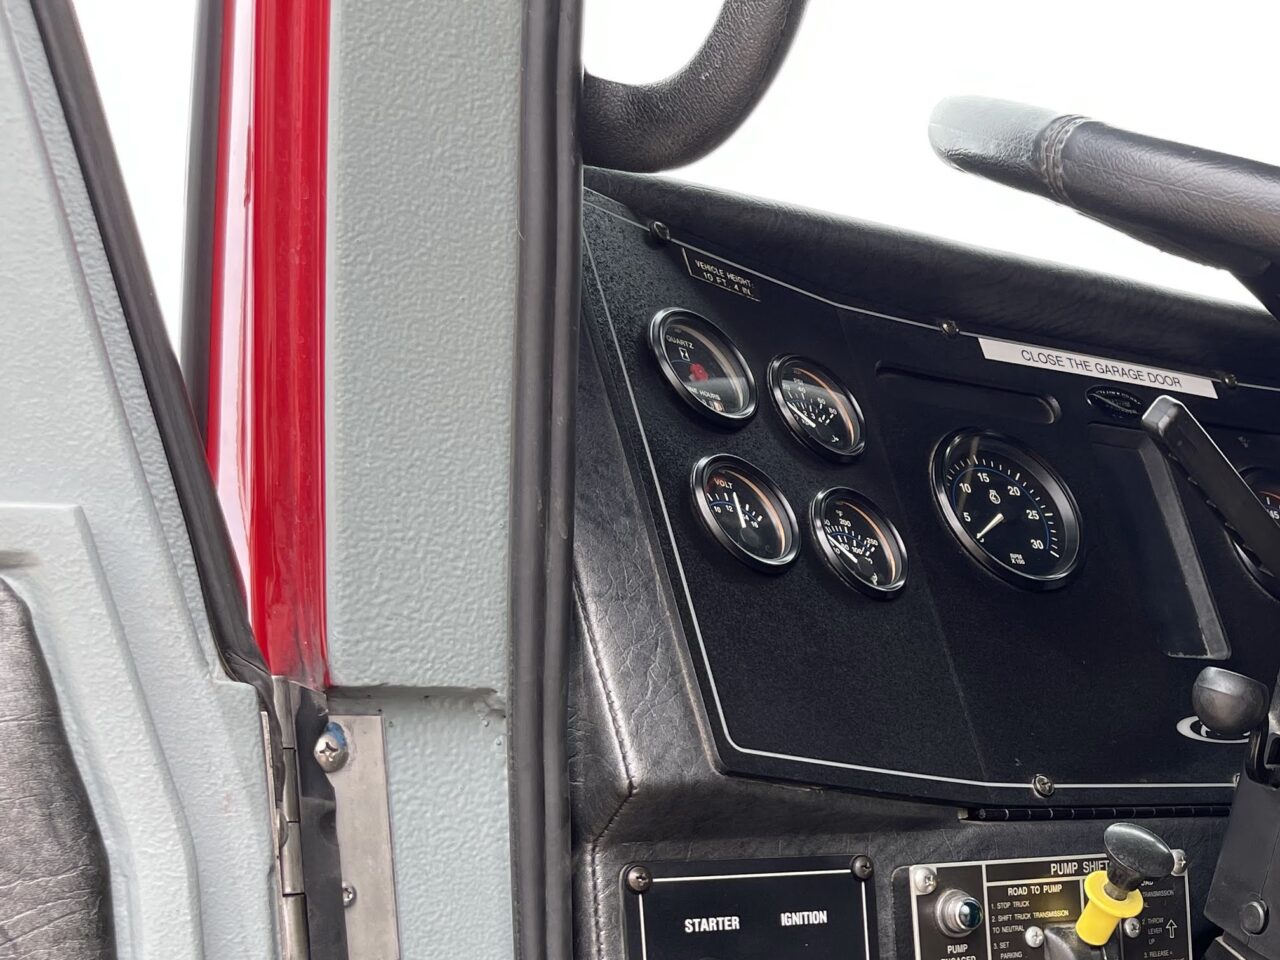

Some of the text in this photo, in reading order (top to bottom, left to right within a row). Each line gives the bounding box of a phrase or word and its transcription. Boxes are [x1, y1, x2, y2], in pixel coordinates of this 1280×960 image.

[695, 260, 725, 277] VEHICLE
[703, 272, 713, 281] 10
[666, 335, 694, 350] QUARTZ
[1021, 349, 1182, 388] CLOSE THE GARAGE DOOR
[700, 390, 721, 400] HOURS
[977, 472, 990, 483] 15
[714, 478, 733, 489] VOLT
[959, 482, 972, 493] 10
[1007, 485, 1021, 496] 20
[725, 505, 734, 513] 12
[1026, 509, 1040, 520] 25
[839, 518, 852, 527] 200
[963, 512, 971, 522] 5
[866, 537, 878, 546] 250
[1030, 539, 1044, 550] 30
[1050, 862, 1078, 875] PUMP
[1008, 884, 1062, 896] ROAD TO PUMP
[781, 910, 828, 926] IGNITION
[1033, 910, 1069, 919] TRANSMISSION
[684, 916, 740, 933] STARTER
[947, 944, 968, 954] PUMP
